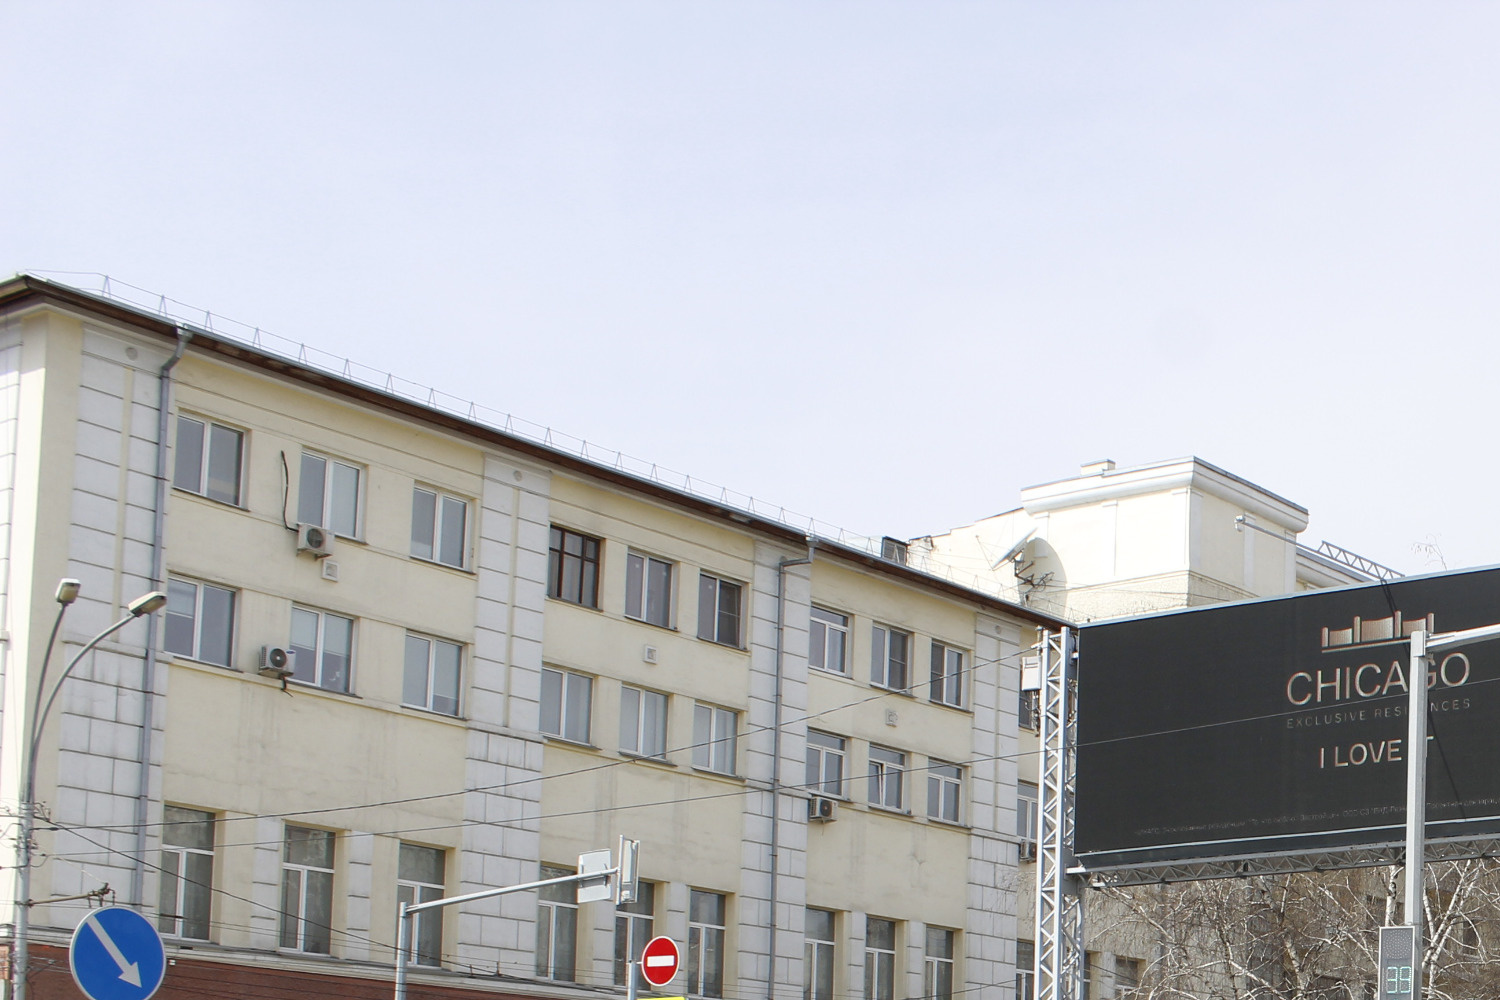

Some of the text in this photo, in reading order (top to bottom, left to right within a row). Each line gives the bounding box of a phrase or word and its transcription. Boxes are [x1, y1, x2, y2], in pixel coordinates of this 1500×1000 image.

[1286, 698, 1471, 729] EXCLUSIVE RESINCES
[1320, 738, 1402, 768] I LOVE
[1386, 966, 1412, 993] 39
